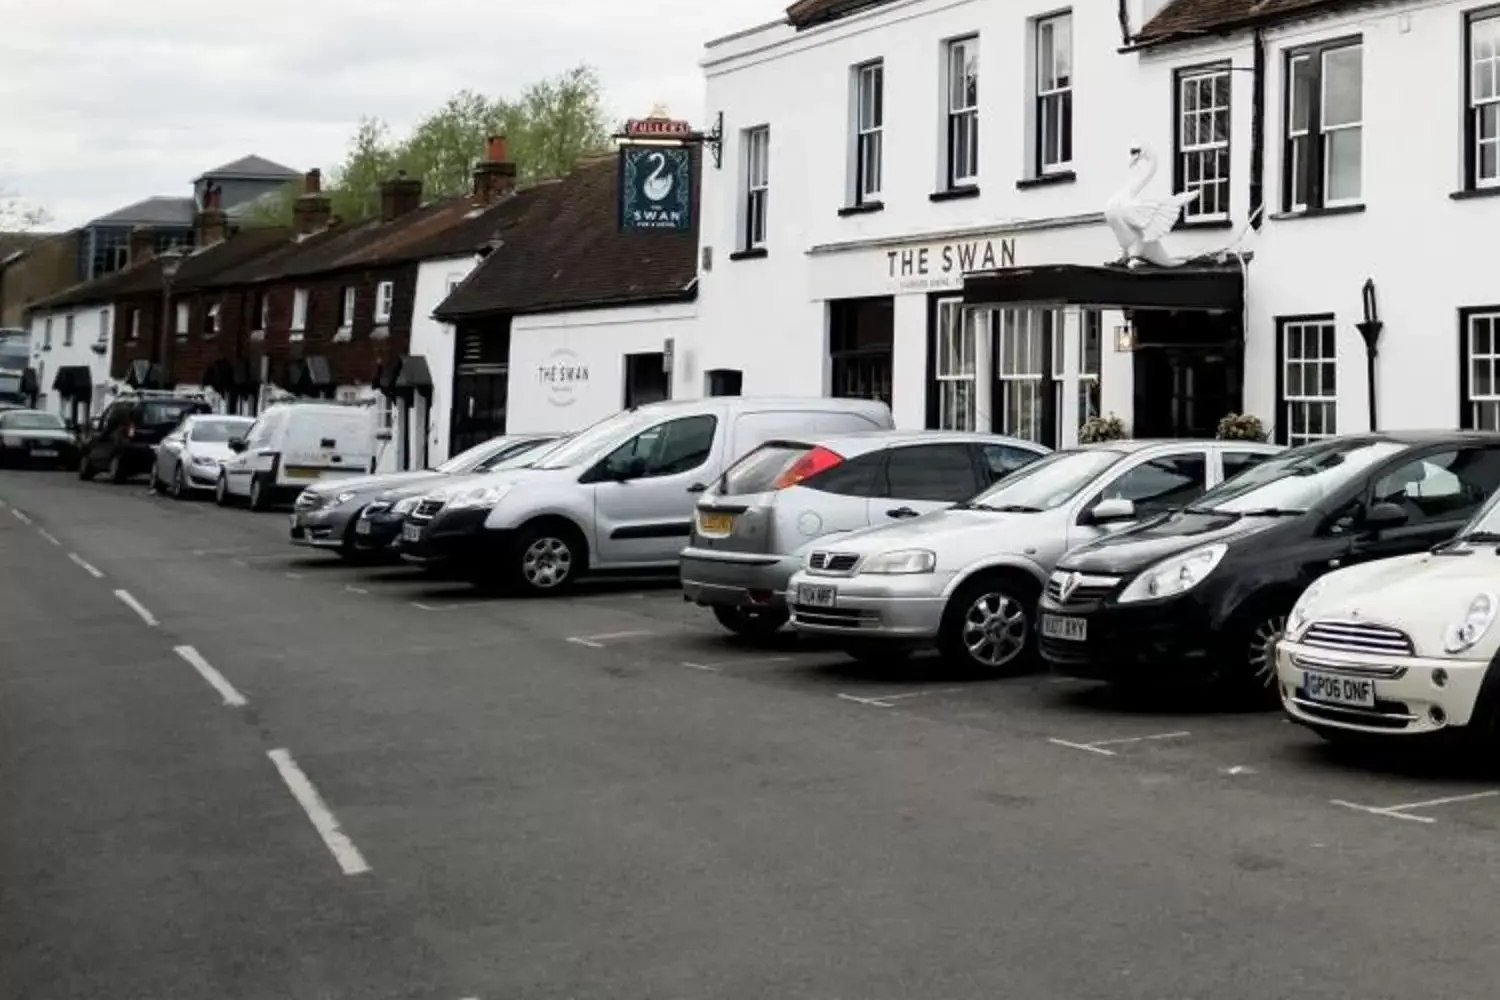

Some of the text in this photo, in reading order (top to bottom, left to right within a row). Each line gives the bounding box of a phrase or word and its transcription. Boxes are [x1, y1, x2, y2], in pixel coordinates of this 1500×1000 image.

[633, 210, 680, 221] SWAN
[887, 238, 1015, 277] THE SWAN
[537, 365, 589, 385] THE SWAN
